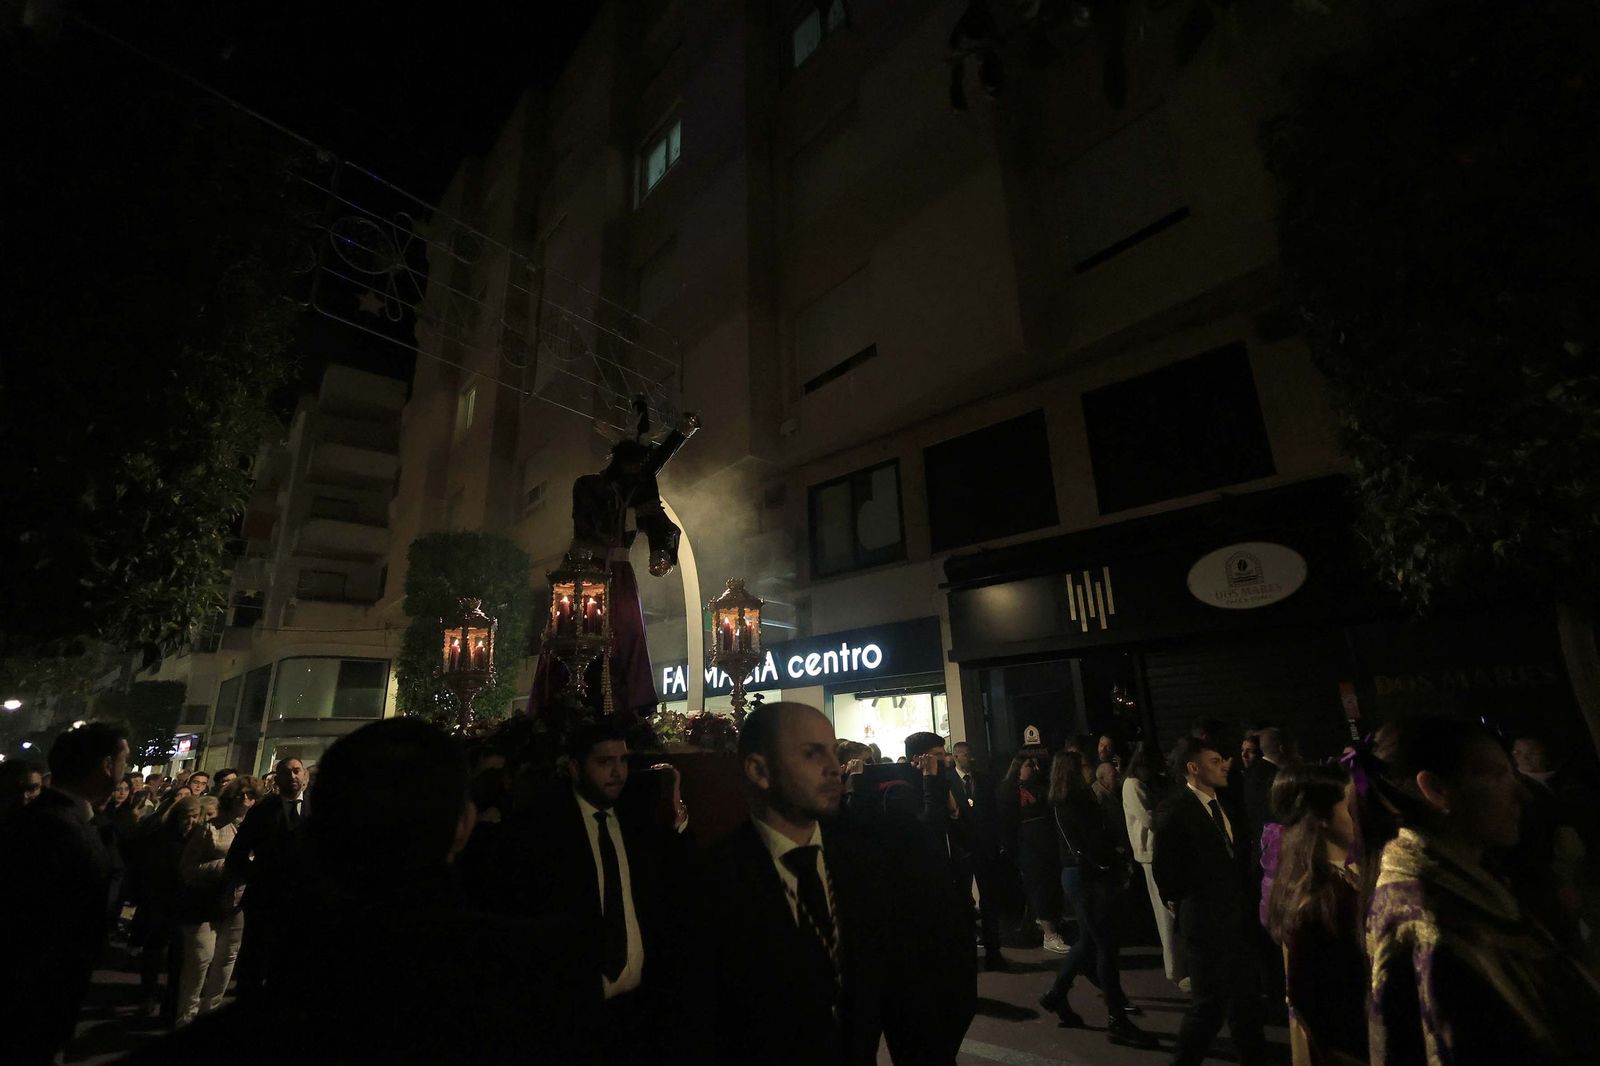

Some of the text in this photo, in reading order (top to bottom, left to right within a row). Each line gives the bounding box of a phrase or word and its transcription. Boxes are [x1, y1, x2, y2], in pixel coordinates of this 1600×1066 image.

[1215, 583, 1282, 600] DOS MARES
[788, 642, 882, 678] centro
[1442, 663, 1558, 690] MARES
